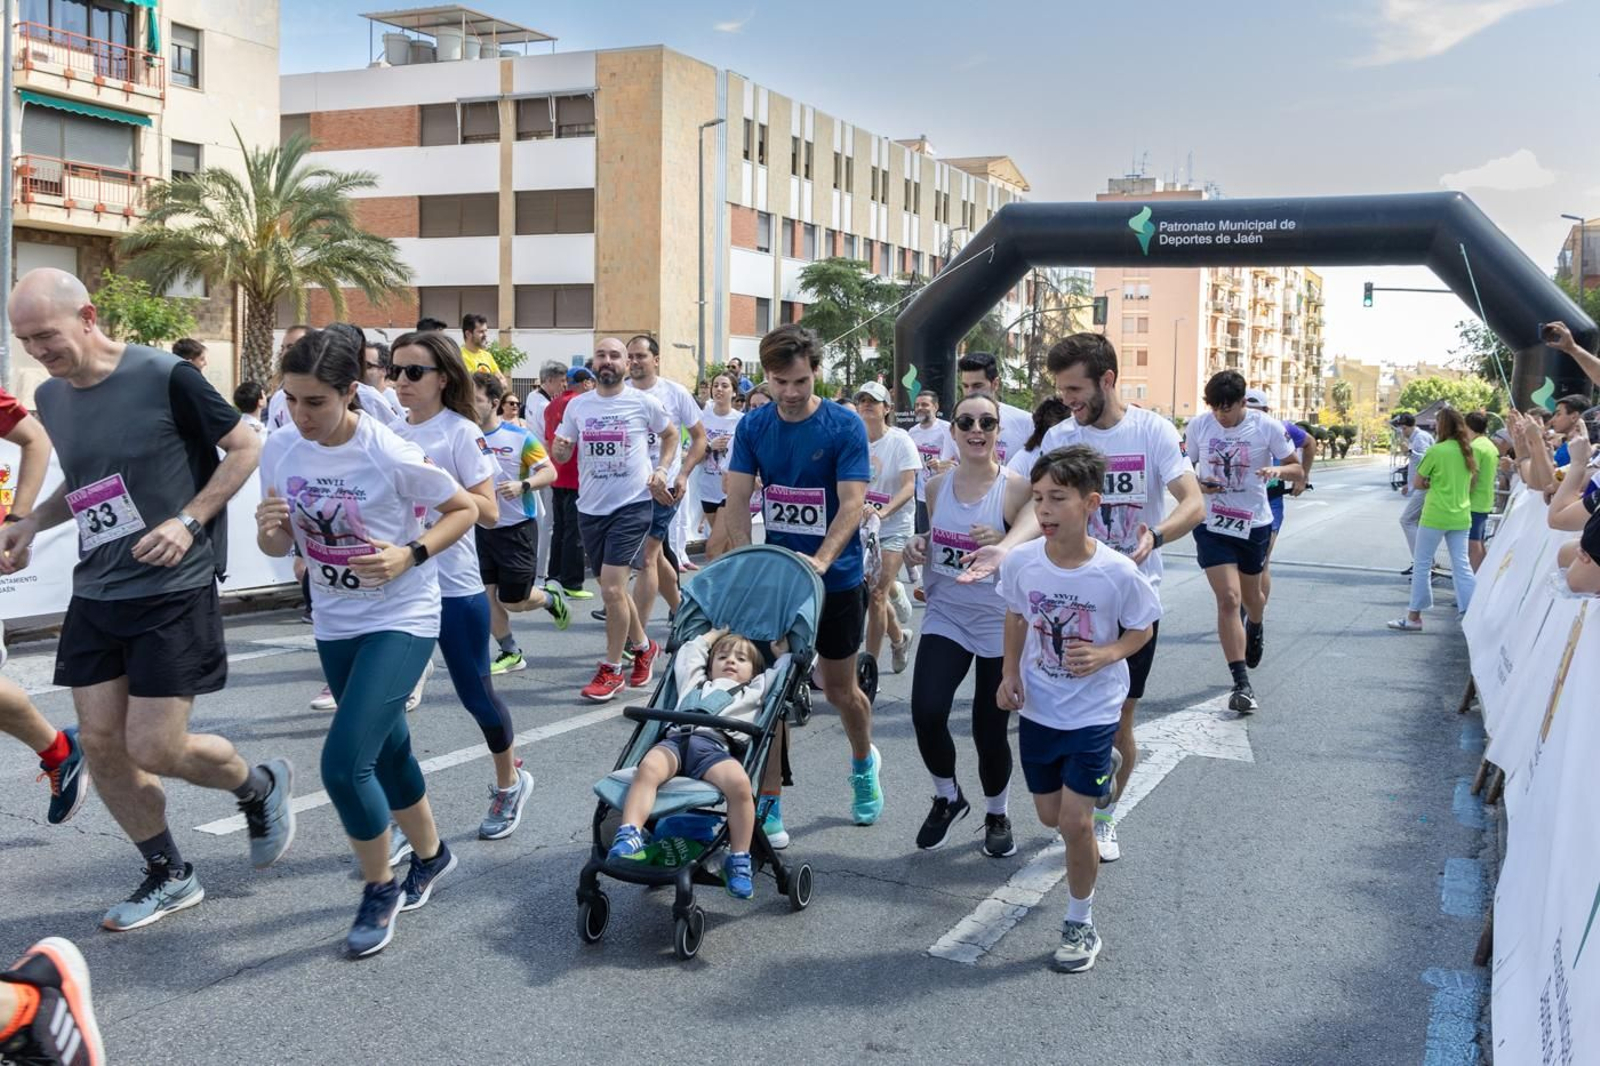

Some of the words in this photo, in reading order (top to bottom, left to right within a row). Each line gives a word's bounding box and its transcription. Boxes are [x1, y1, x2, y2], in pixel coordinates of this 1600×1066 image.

[1159, 220, 1216, 232] Patronato
[1218, 219, 1277, 232] Municipal
[1279, 219, 1297, 230] de
[1159, 233, 1212, 247] Deportes
[1215, 233, 1231, 244] de
[1233, 232, 1264, 244] Jaén
[647, 432, 657, 445] 3
[588, 441, 617, 457] 188
[1102, 472, 1134, 495] 18
[86, 502, 119, 534] 33
[771, 502, 819, 526] 220
[1213, 514, 1246, 533] 274
[0, 575, 38, 586] NTAMIENTO
[321, 564, 361, 590] 96
